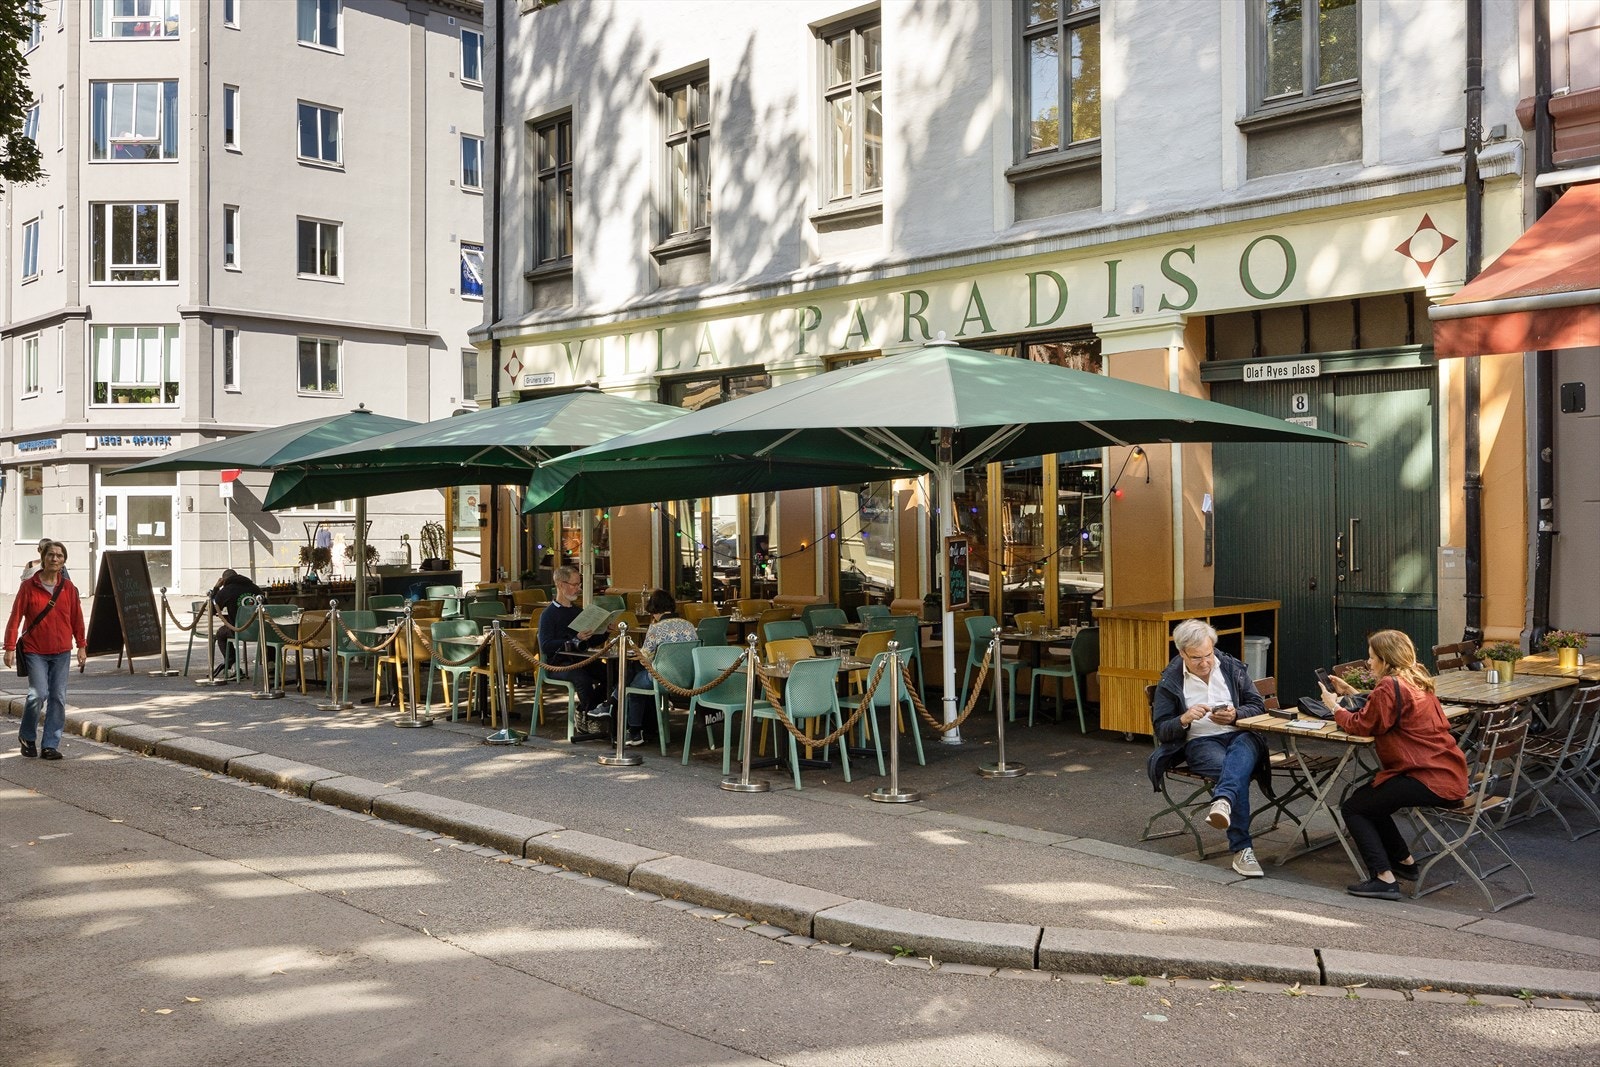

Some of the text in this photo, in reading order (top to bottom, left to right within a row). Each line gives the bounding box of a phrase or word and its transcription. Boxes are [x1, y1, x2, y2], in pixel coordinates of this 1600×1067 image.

[561, 234, 1297, 383] VILLA PARADISO
[1246, 363, 1316, 379] Olaf Ryes plass
[1296, 395, 1305, 410] 8
[99, 435, 122, 446] LEGE
[132, 435, 172, 446] APOTEK
